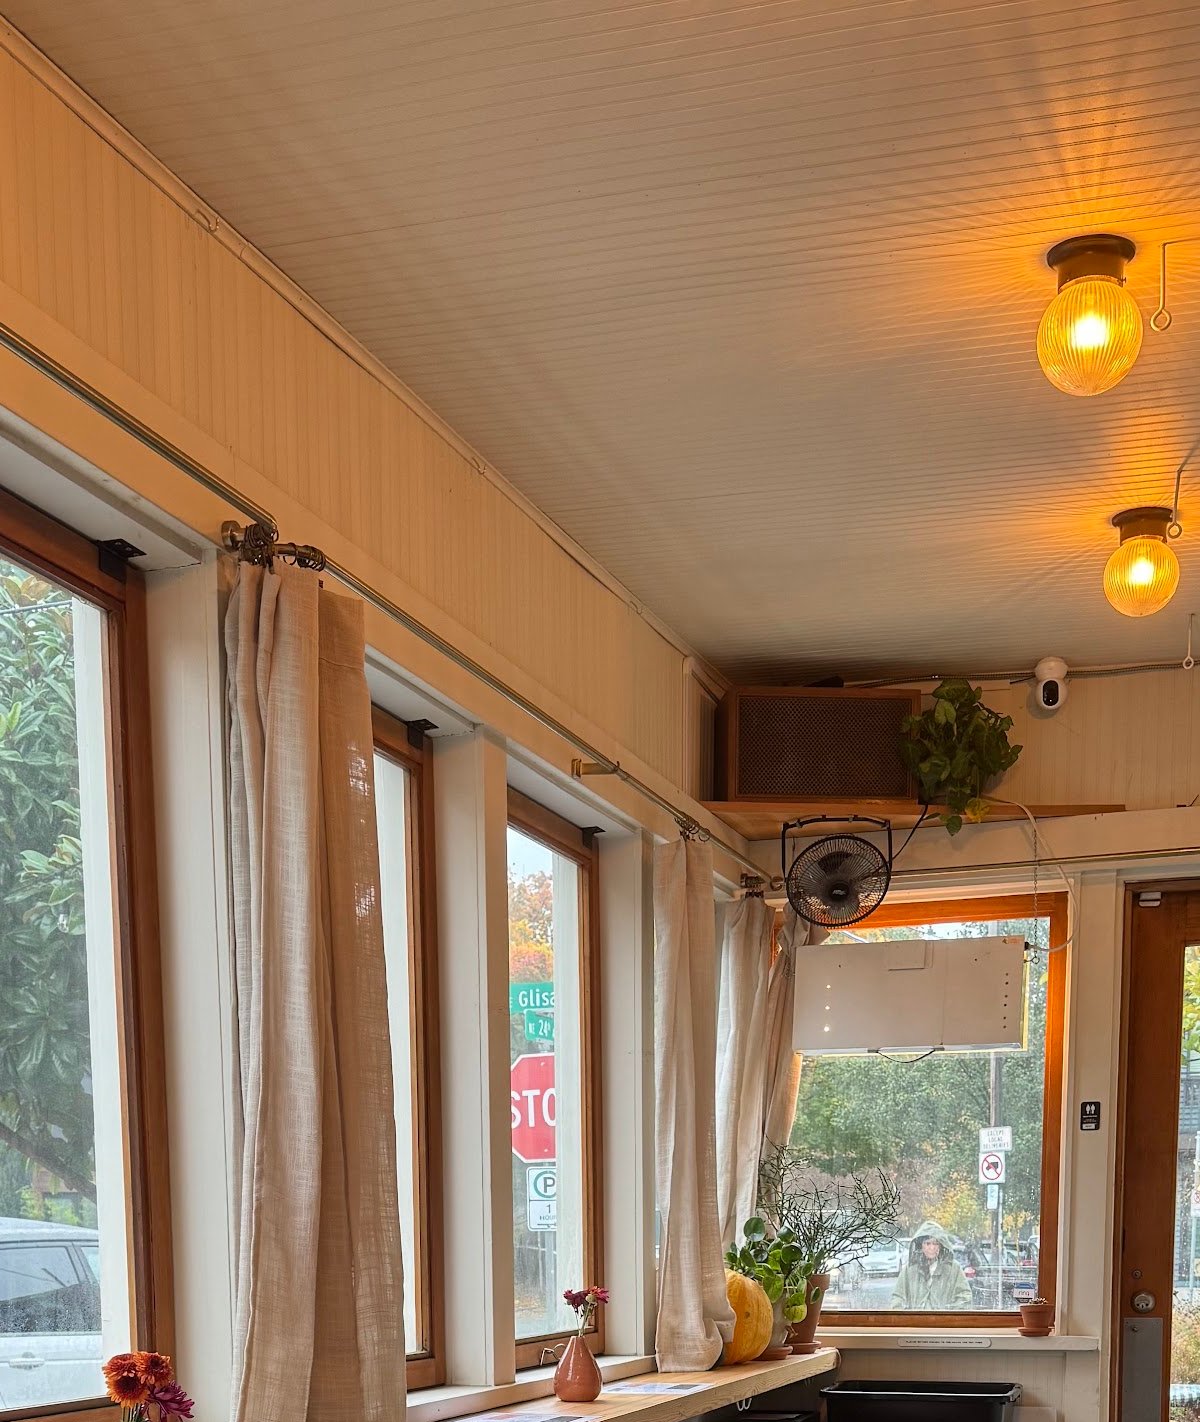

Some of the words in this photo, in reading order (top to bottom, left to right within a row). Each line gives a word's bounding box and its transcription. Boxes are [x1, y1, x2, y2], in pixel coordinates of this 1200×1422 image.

[511, 1087, 556, 1129] STO
[543, 1176, 556, 1194] P
[545, 1203, 551, 1214] 1
